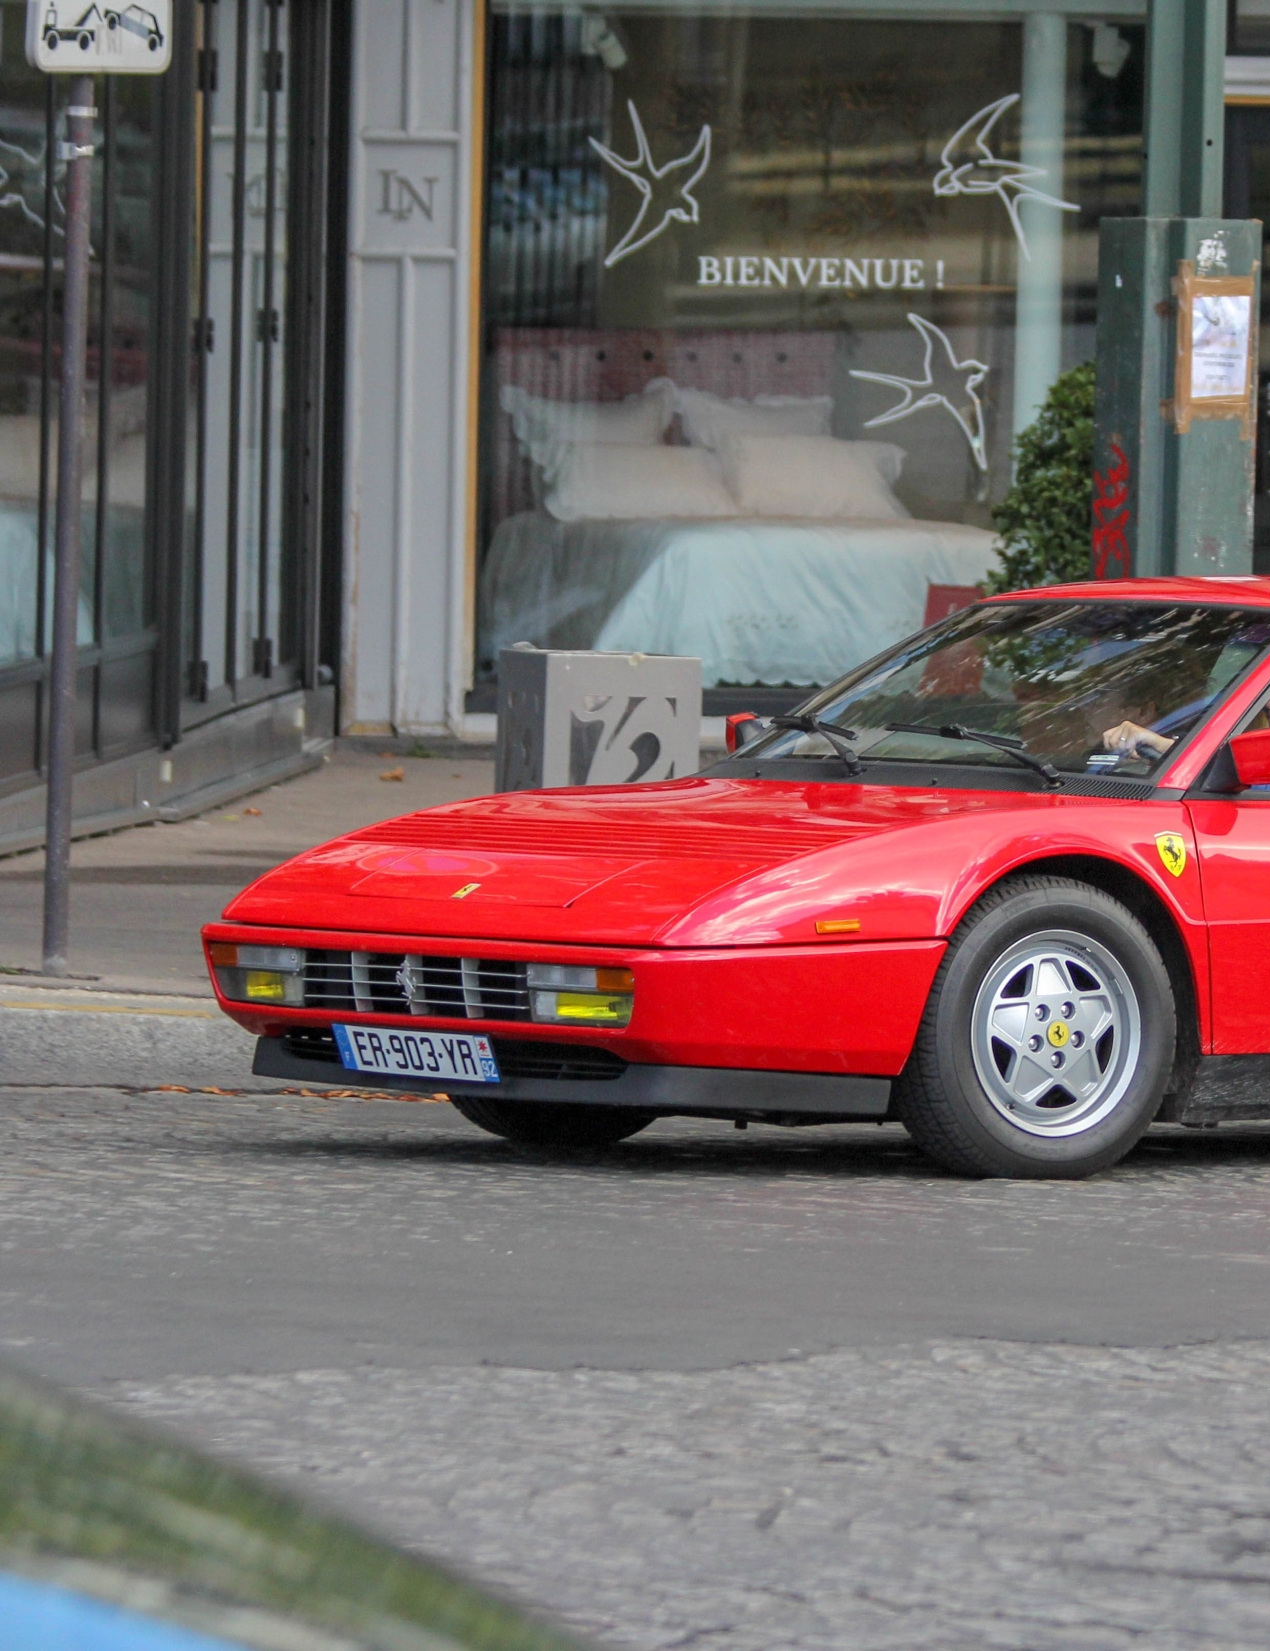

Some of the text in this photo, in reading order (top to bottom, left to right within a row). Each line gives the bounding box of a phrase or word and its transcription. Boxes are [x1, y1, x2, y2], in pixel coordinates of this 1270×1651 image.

[377, 169, 439, 221] LN
[697, 256, 946, 290] BIENVENUE !
[482, 1060, 498, 1077] 92
